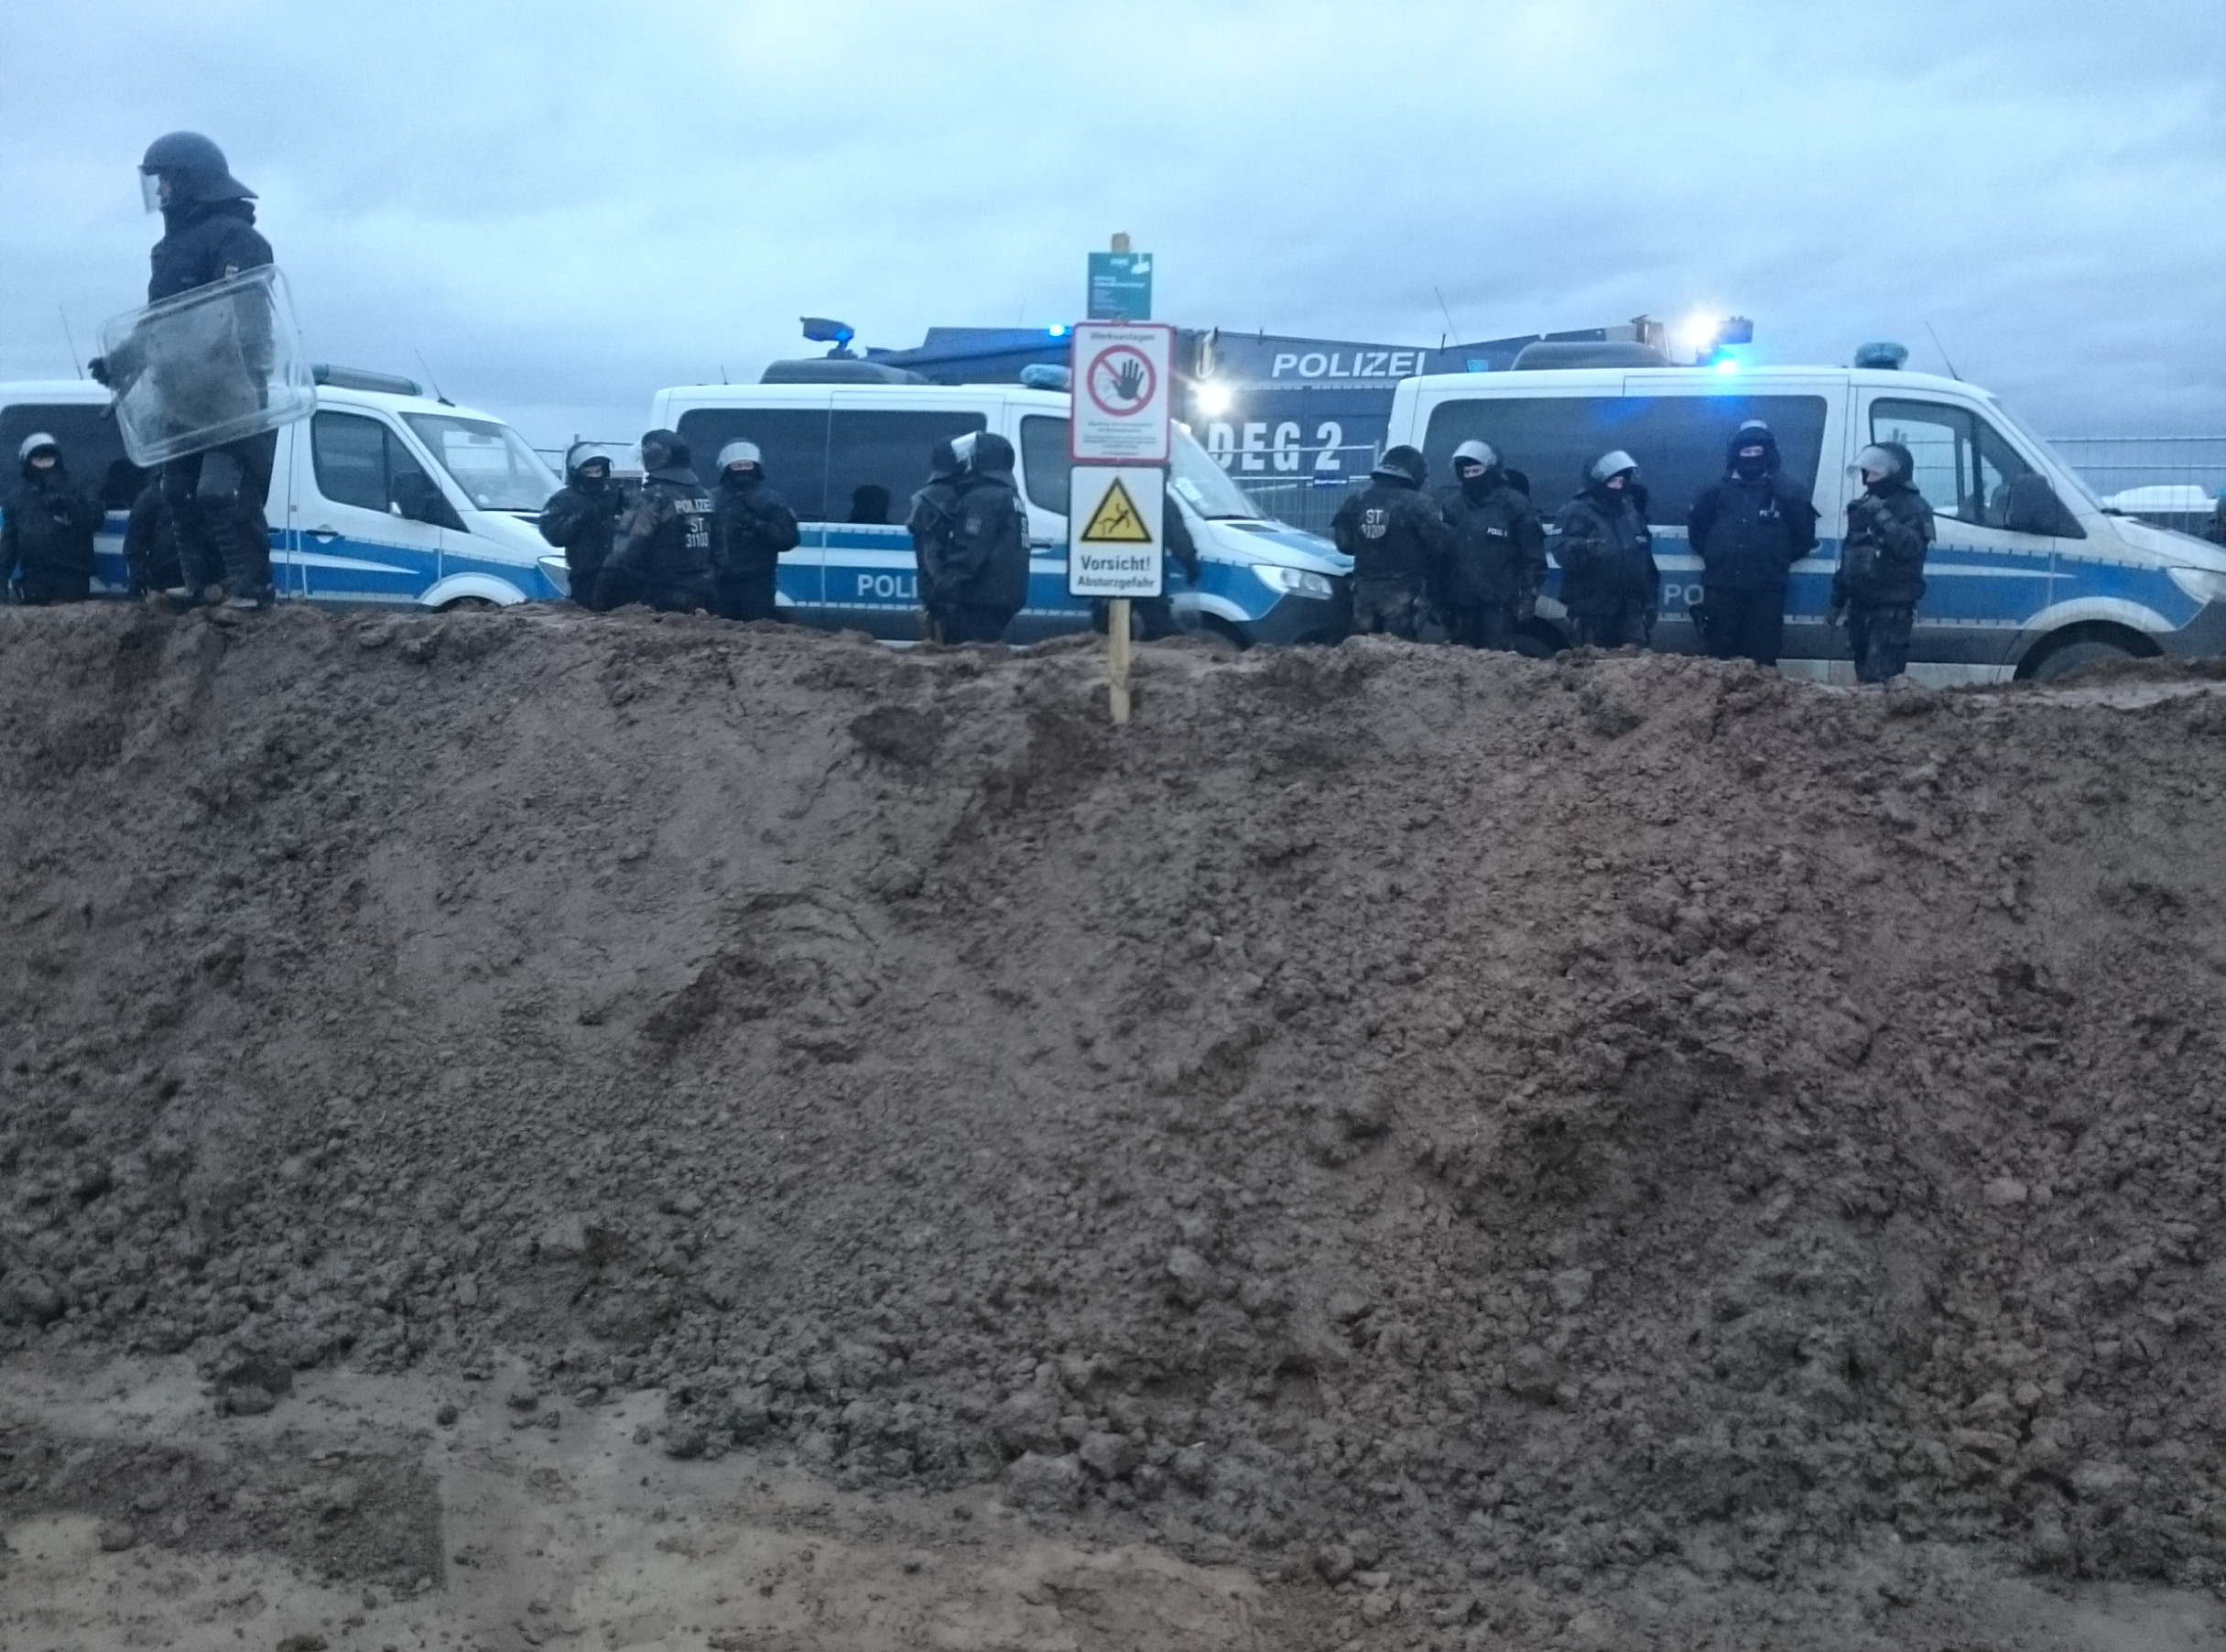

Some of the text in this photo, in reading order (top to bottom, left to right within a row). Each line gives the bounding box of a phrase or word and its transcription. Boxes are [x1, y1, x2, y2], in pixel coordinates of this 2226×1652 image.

[1272, 352, 1426, 377] POLIZEI
[1208, 421, 1342, 471] DEG 2
[1366, 509, 1384, 524] ST
[1080, 555, 1151, 571] Vorsicht!
[857, 574, 918, 598] POLI
